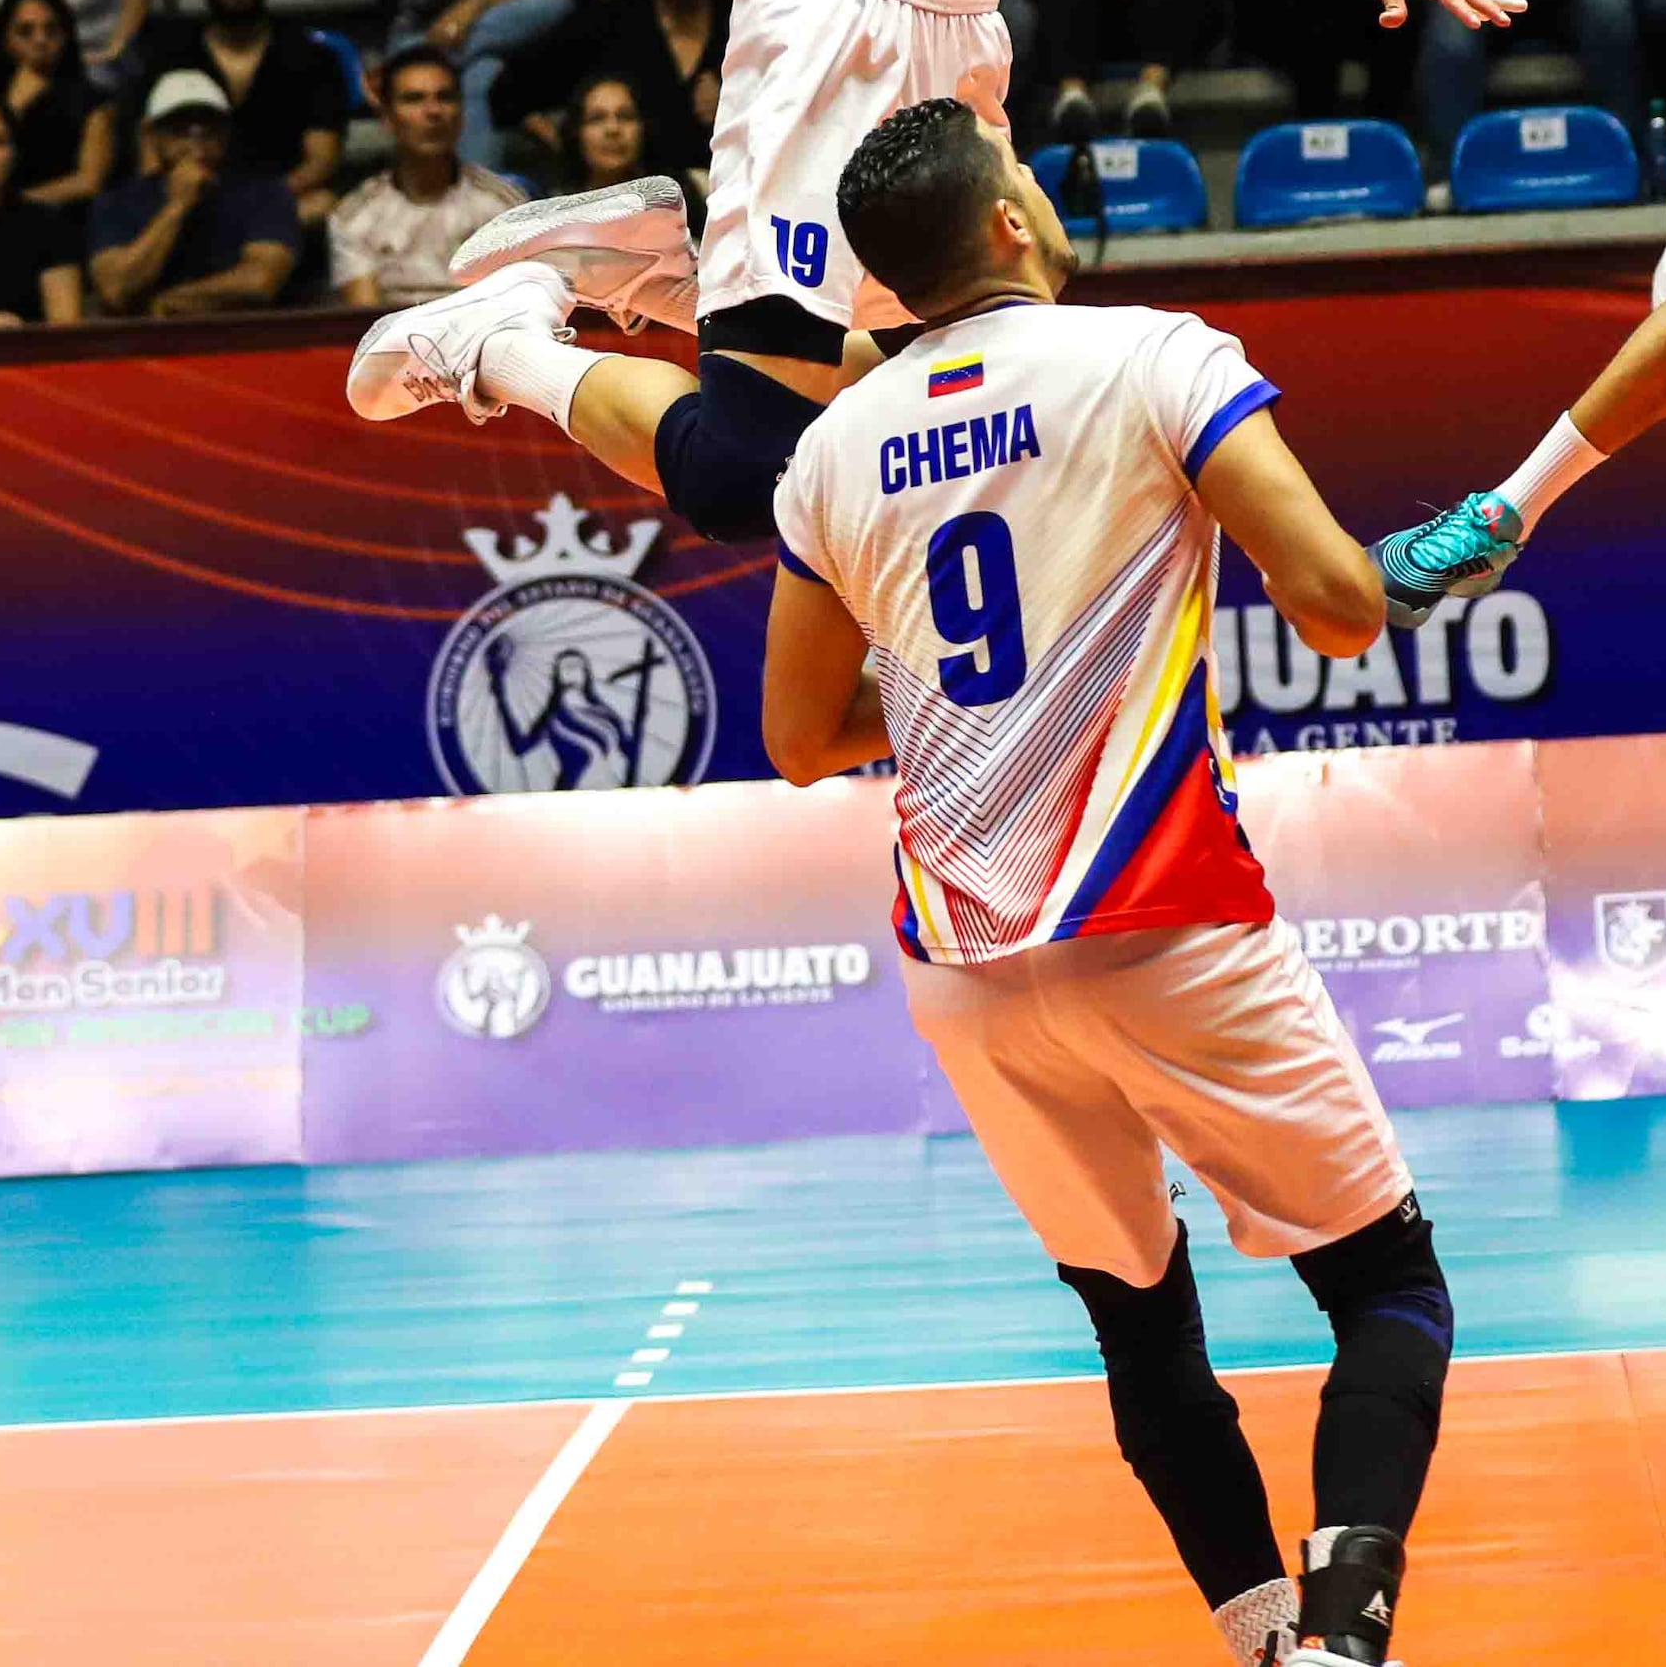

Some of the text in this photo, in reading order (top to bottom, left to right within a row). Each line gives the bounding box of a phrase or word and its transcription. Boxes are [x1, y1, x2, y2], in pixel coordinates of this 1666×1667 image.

[770, 215, 828, 288] 19
[880, 404, 1042, 495] CHEMA
[926, 511, 1027, 707] 9
[1294, 718, 1459, 752] GENTE
[5, 889, 213, 963] XVIII
[564, 944, 871, 998] GUANAJUATO
